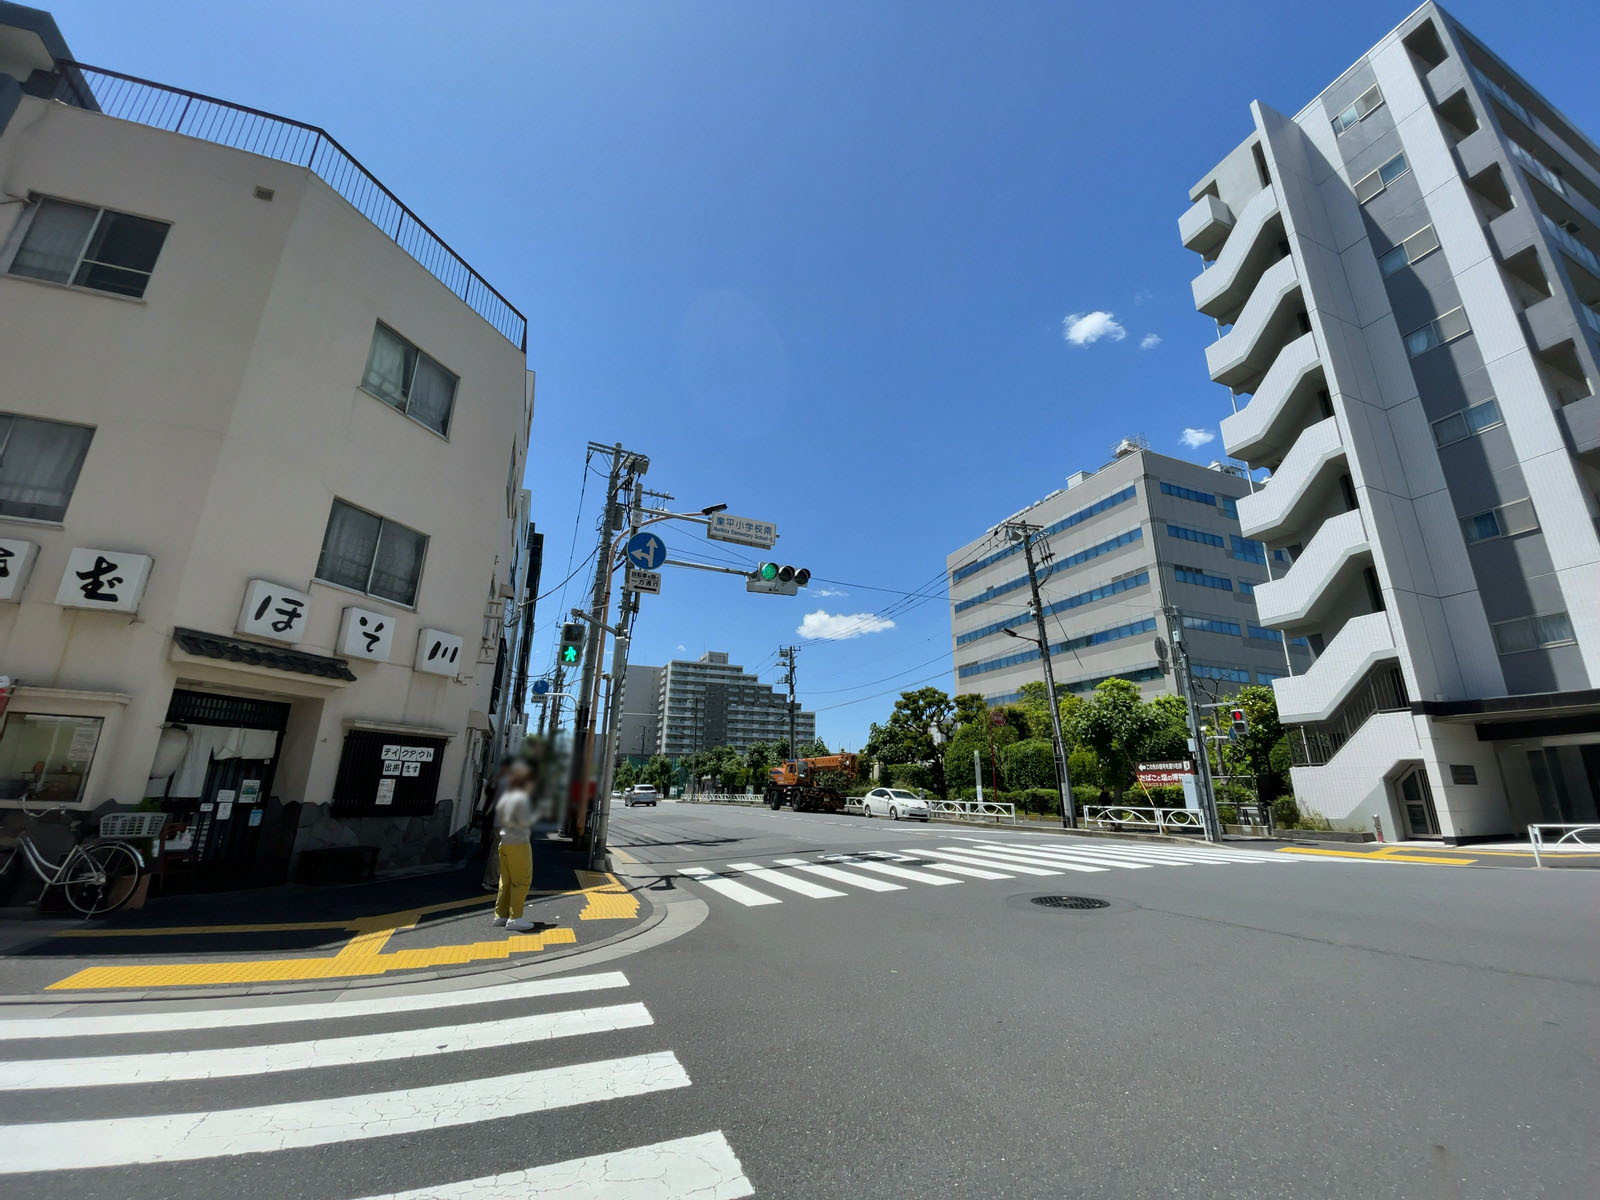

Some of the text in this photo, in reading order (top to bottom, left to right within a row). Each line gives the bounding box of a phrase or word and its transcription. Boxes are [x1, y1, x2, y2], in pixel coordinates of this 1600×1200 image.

[631, 579, 659, 588] 一方通行
[384, 748, 432, 759] テイクアウト
